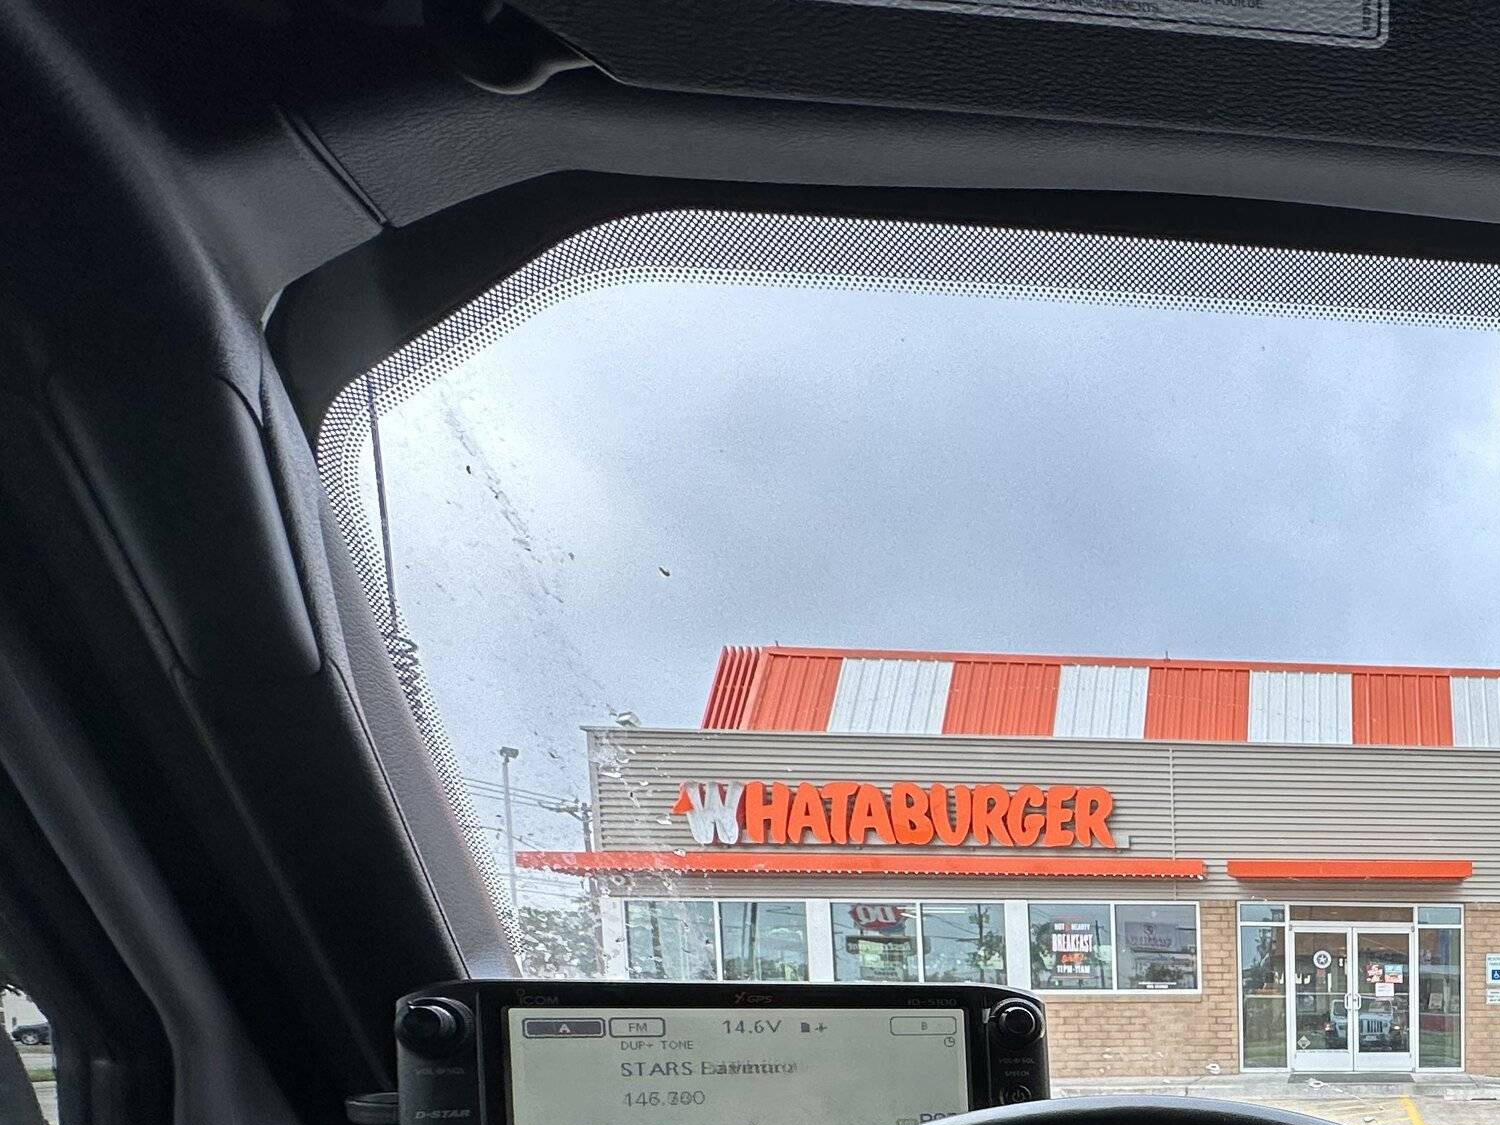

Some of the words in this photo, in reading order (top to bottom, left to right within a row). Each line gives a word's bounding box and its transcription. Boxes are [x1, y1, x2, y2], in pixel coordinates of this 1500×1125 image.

[676, 780, 1116, 848] WHATABURGER
[1051, 933, 1093, 952] BREAKFAST
[559, 1023, 571, 1034] A
[628, 1022, 648, 1033] FM
[722, 1020, 782, 1034] 14.6V
[920, 1022, 928, 1031] B
[661, 1040, 694, 1050] TONE
[621, 1062, 693, 1077] STARS
[415, 1109, 472, 1120] D-STAR
